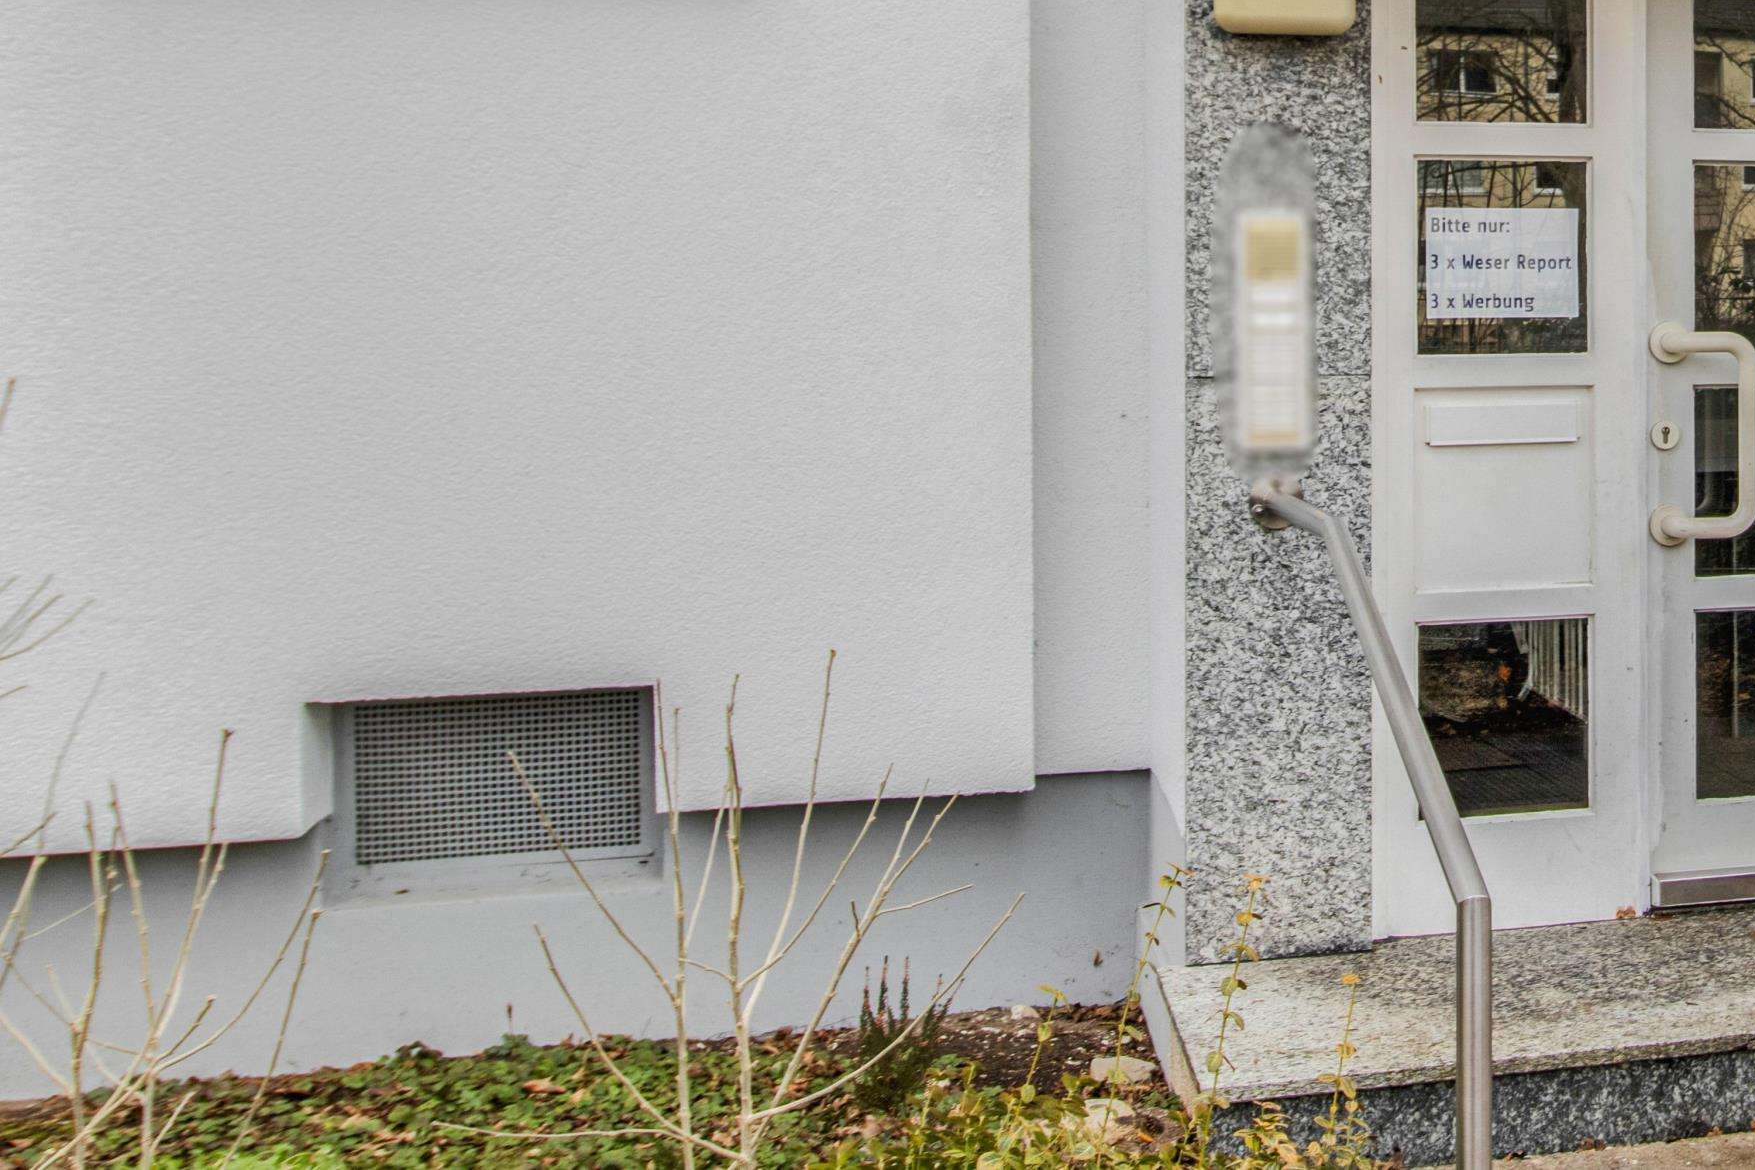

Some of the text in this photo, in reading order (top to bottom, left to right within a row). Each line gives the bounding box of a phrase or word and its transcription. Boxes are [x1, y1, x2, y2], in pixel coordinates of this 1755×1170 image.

[1431, 217, 1510, 233] Bitte nur:
[1431, 255, 1572, 272] 3 x Weser Report
[1431, 294, 1534, 312] 3 x Werbung
